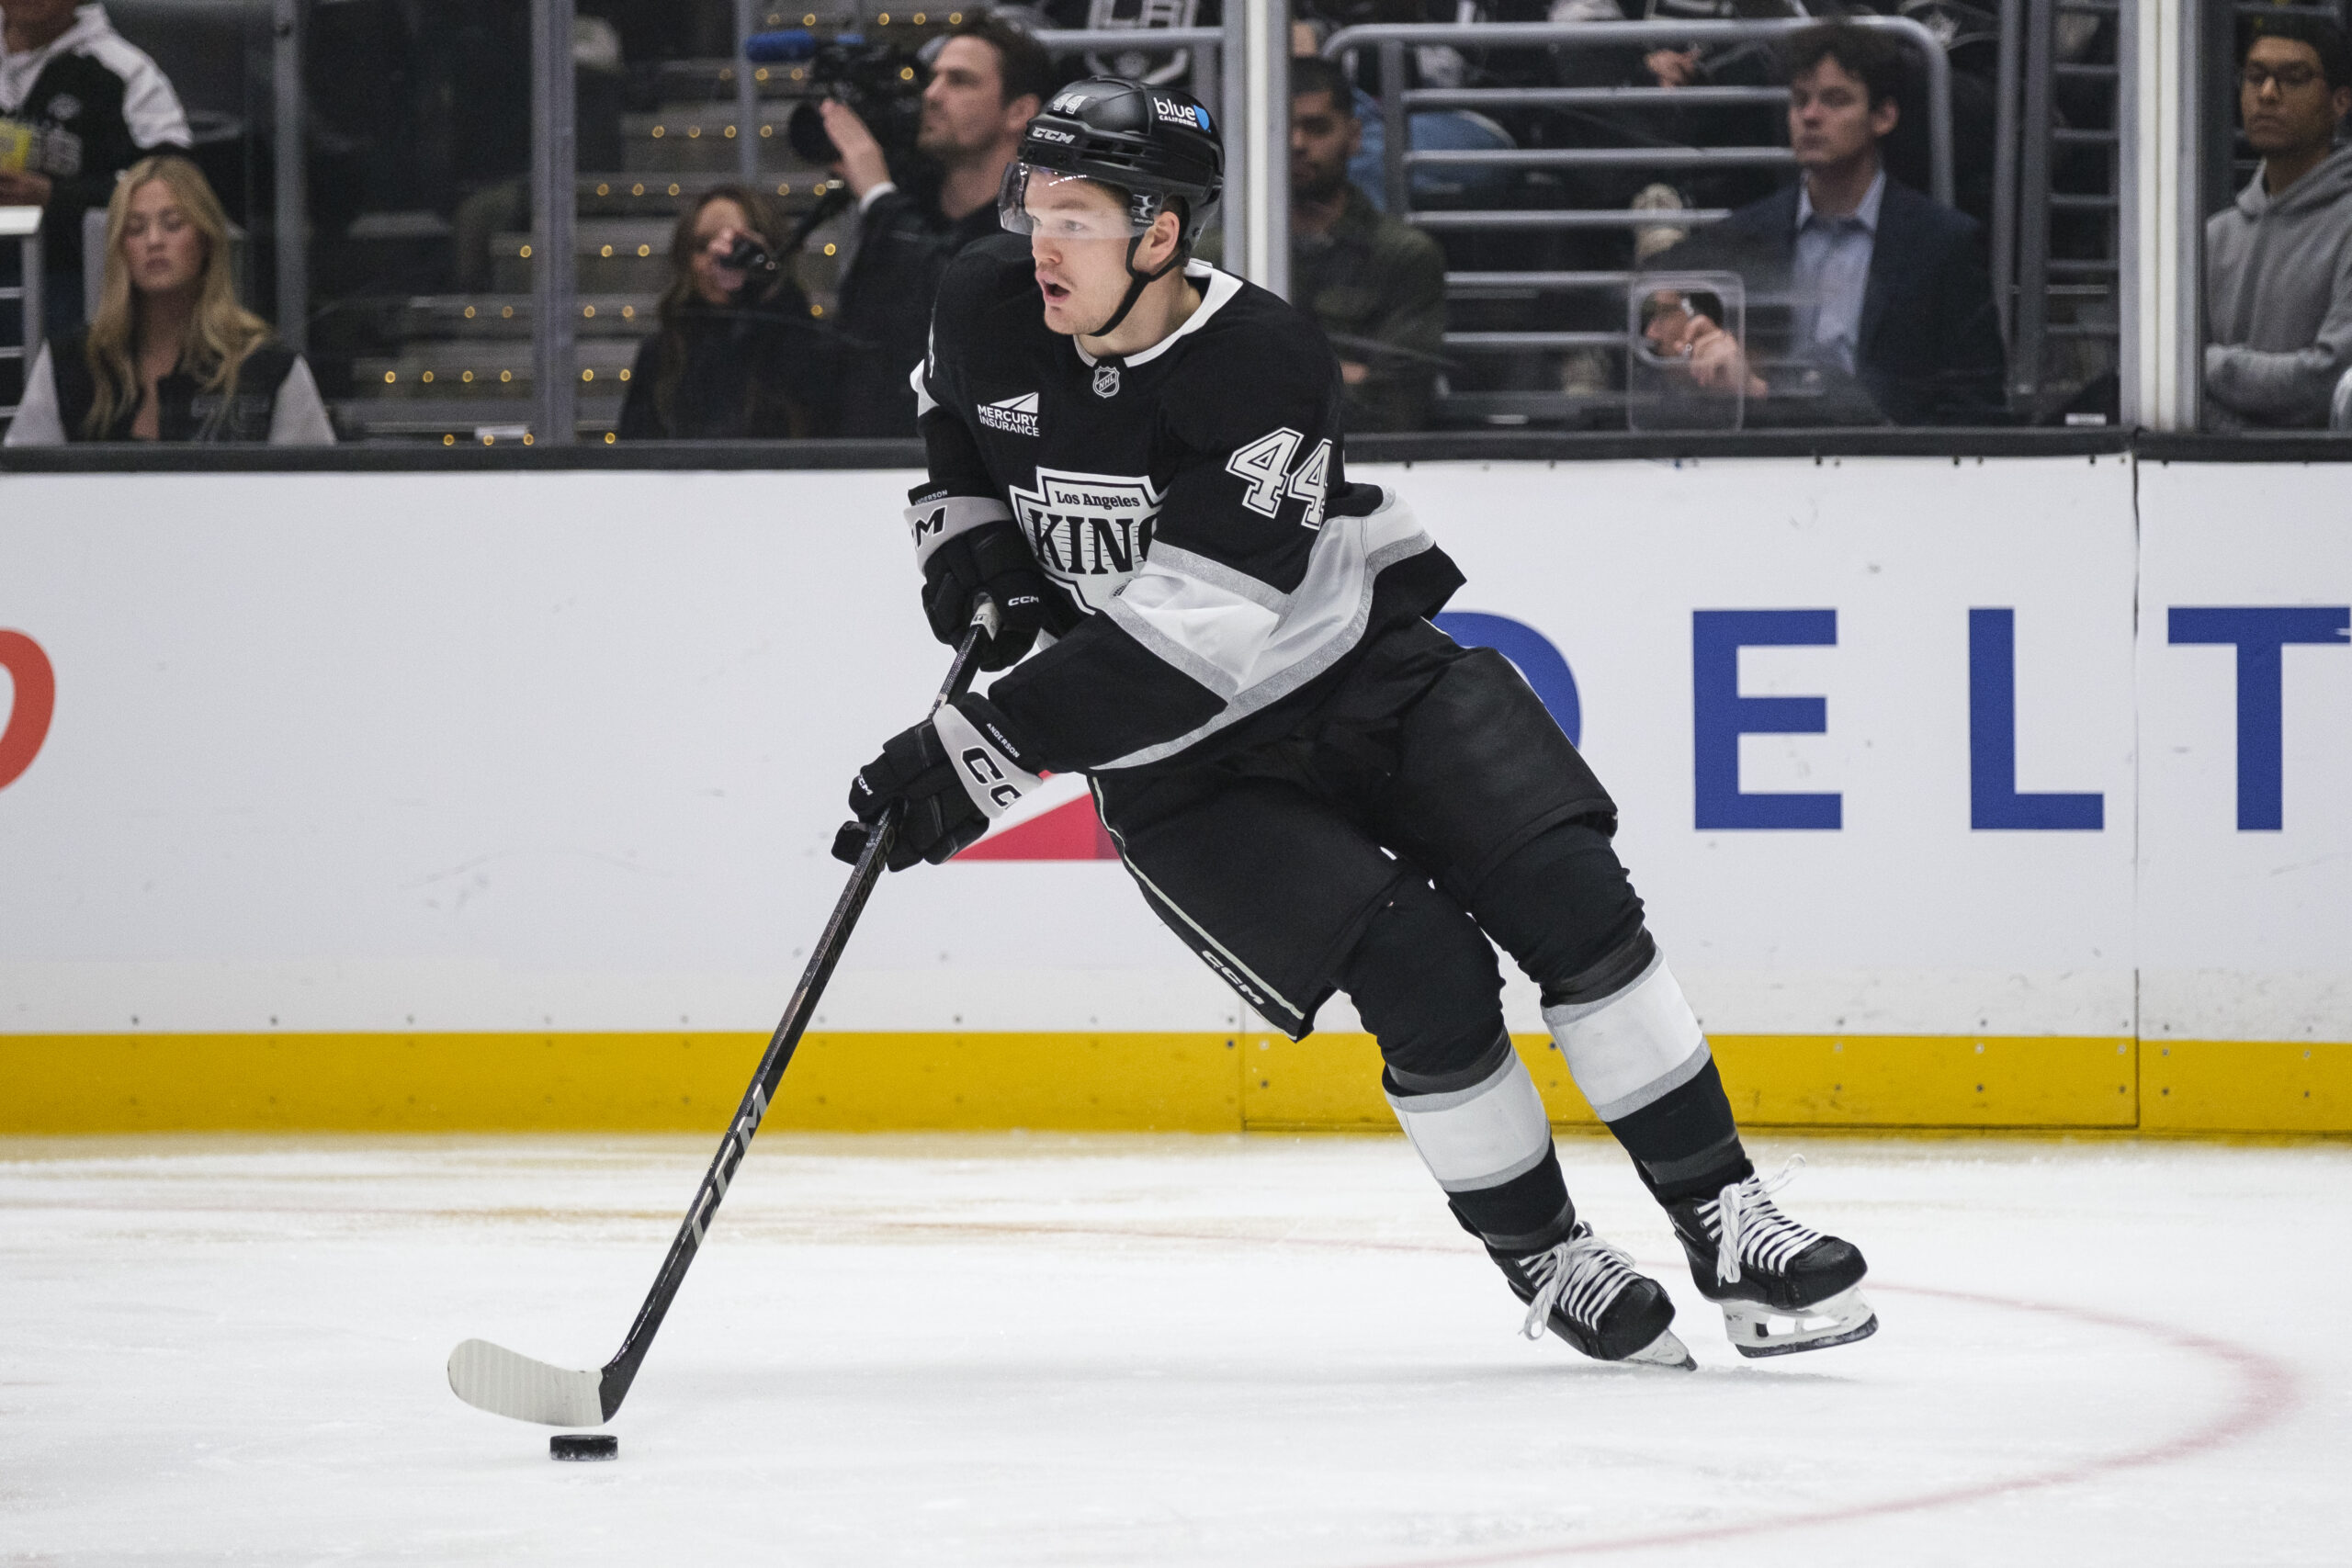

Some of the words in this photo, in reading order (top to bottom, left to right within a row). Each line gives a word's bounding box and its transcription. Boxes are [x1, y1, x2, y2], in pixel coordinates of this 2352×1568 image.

[1053, 93, 1088, 115] 44
[1153, 96, 1196, 121] blue
[1032, 127, 1076, 143] CCM
[1098, 375, 1115, 390] NHL
[977, 404, 1038, 427] MERCURY
[979, 415, 1040, 437] INSURANCE
[1225, 426, 1333, 531] 44
[1055, 491, 1080, 504] Los
[1082, 493, 1140, 510] Angeles
[1008, 596, 1039, 606] CCM
[986, 722, 1020, 759] ANDERSON
[1202, 950, 1265, 1005] CCM
[691, 1082, 769, 1249] CCM
